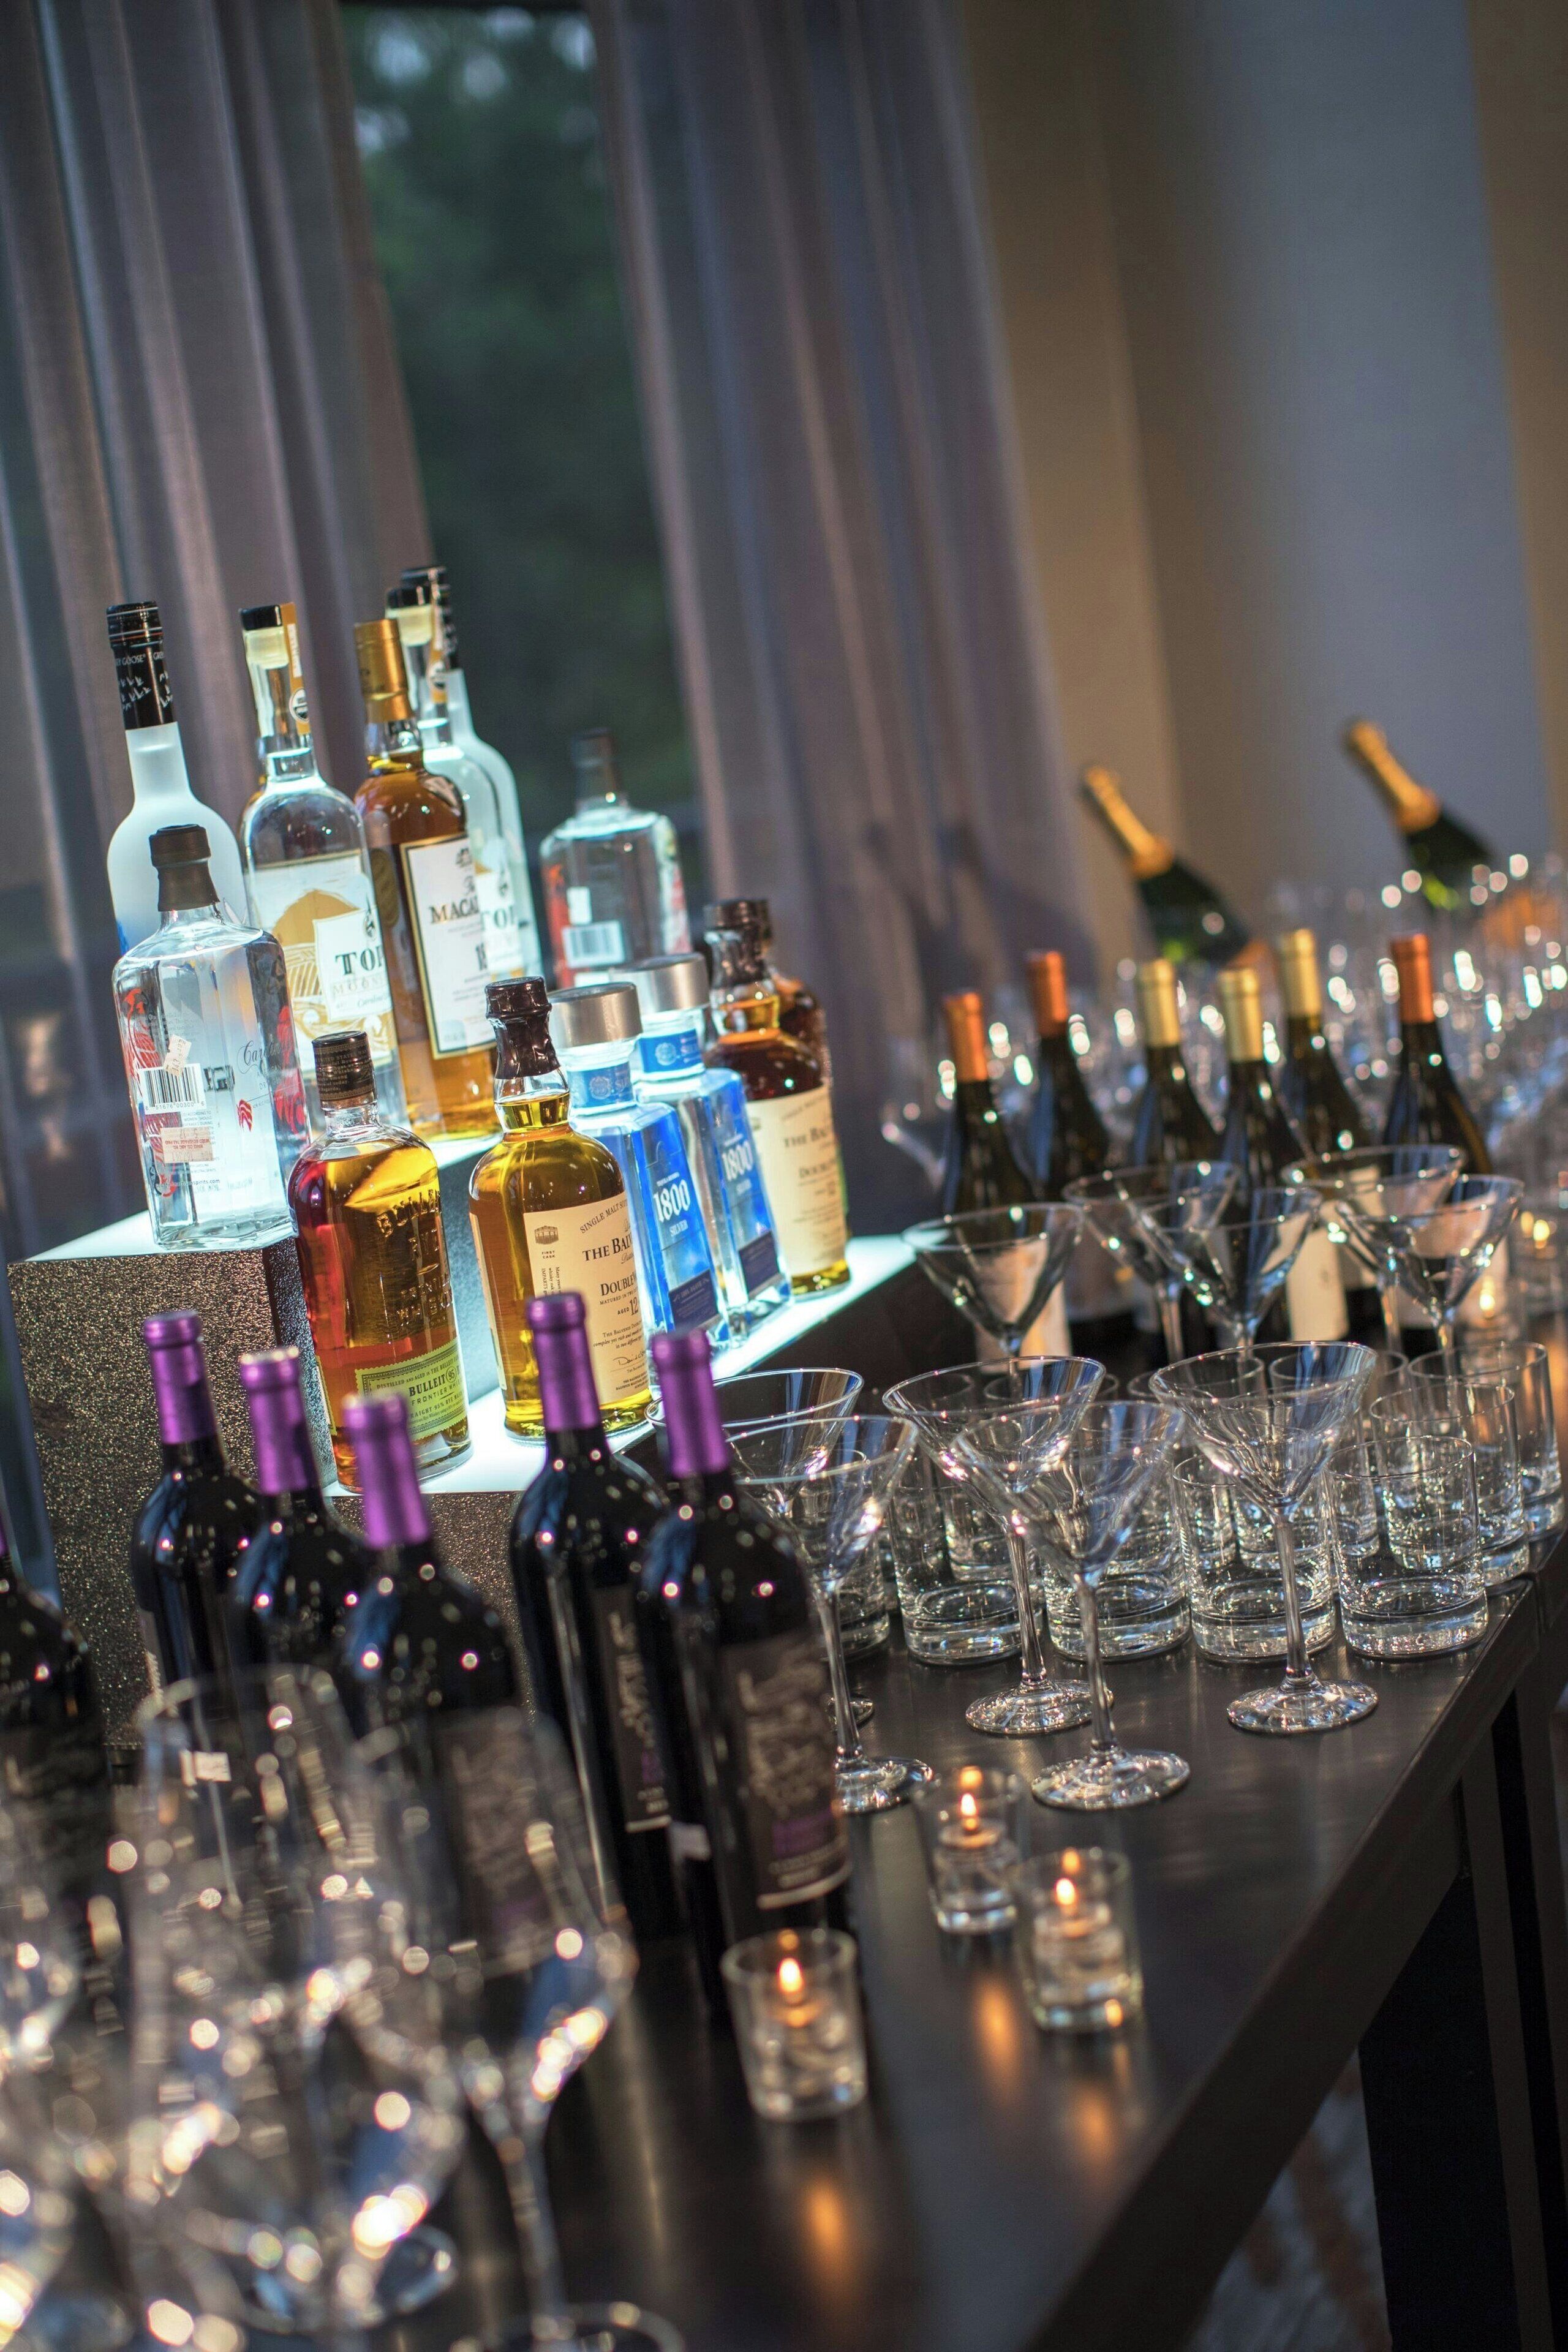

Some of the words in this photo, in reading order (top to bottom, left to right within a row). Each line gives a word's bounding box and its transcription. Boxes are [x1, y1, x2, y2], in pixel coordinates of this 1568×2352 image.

[722, 1140, 753, 1182] 1800
[653, 1179, 691, 1223] 1800
[579, 1212, 605, 1234] SINGLE
[605, 1202, 620, 1218] MALT
[582, 1245, 610, 1261] THE
[600, 1295, 622, 1305] MATURED
[617, 1306, 630, 1316] AGED
[630, 1296, 639, 1316] 12
[377, 1379, 405, 1389] DISTILLED
[431, 1366, 439, 1374] THE
[409, 1374, 445, 1397] BULLEIT
[411, 1387, 447, 1406] FRONTIER
